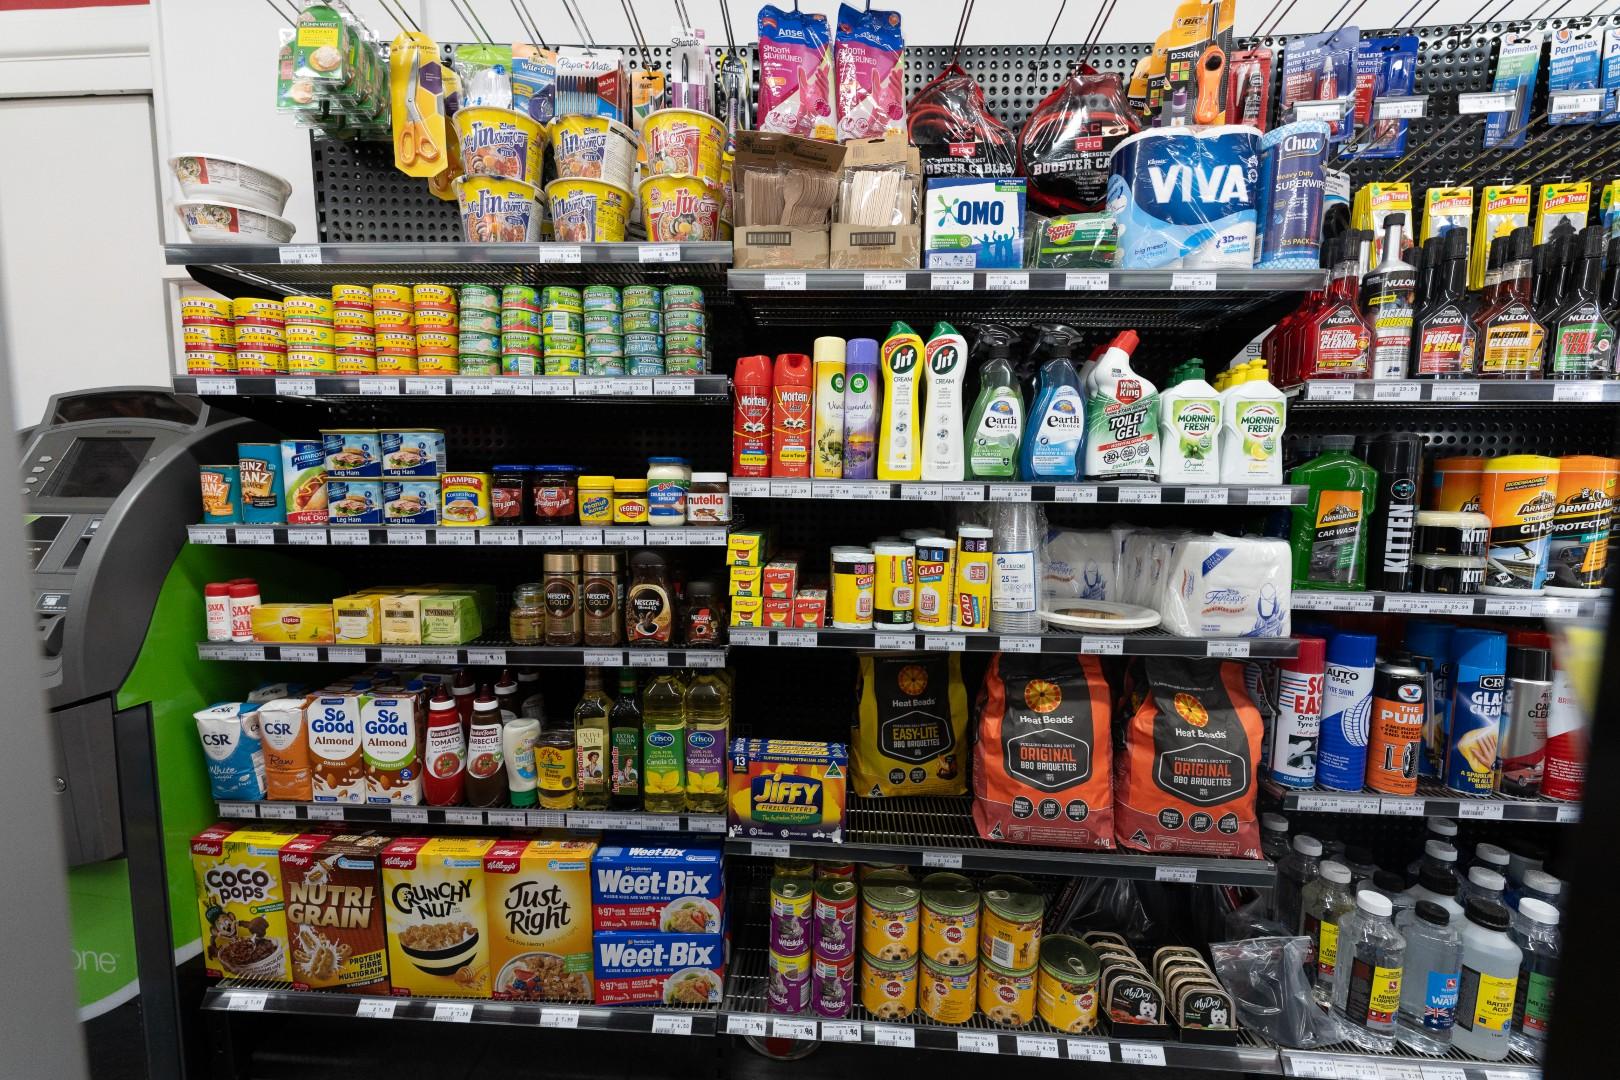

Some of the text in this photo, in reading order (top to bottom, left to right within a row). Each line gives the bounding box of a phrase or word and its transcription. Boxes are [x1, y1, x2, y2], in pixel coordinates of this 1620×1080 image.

[671, 37, 701, 49] Sharpie
[1555, 40, 1598, 56] Permatex
[763, 45, 790, 54] SMOOTH
[1171, 50, 1200, 60] DESIGN
[1502, 45, 1538, 56] Permatex
[558, 57, 612, 71] Paper Mate
[763, 53, 803, 63] SILVERLINED
[471, 122, 495, 151] Jin
[1076, 140, 1103, 149] PRO
[1284, 136, 1318, 152] Chux
[1033, 160, 1090, 176] BOOSTER
[1276, 170, 1313, 182] Heavy Duty
[1147, 164, 1249, 204] VIVA
[476, 189, 503, 219] Jin
[674, 188, 698, 219] Jin
[1372, 192, 1409, 206] Little Trees
[1431, 198, 1471, 211] Little Trees
[1488, 197, 1527, 211] Little Trees
[1544, 194, 1586, 210] Little Trees
[957, 200, 1004, 225] OMO
[1047, 222, 1077, 235] Scotch
[1050, 229, 1075, 242] Brite
[1384, 278, 1416, 288] NULON
[1328, 317, 1355, 325] NULON
[1432, 317, 1461, 325] NULON
[1498, 314, 1529, 322] NULON
[1424, 334, 1461, 344] BOOST
[1489, 331, 1528, 339] INJECTOR
[1489, 338, 1529, 347] CLEANER
[896, 347, 914, 367] Jif
[935, 348, 953, 371] Jif
[781, 392, 808, 403] Mortein
[1120, 388, 1140, 399] King
[741, 396, 767, 407] Mortein
[985, 415, 1017, 429] earth
[1047, 415, 1079, 429] earth
[1110, 409, 1147, 431] TOILET
[1177, 415, 1216, 423] MORNING
[1241, 416, 1280, 425] MORNING
[1116, 425, 1141, 441] GEL
[1184, 423, 1210, 431] FRESH
[1247, 424, 1274, 433] FRESH
[445, 476, 478, 485] HAMPER
[687, 496, 724, 506] nutella
[314, 514, 328, 522] Dog
[336, 516, 347, 524] Leg
[1318, 526, 1359, 538] CAR WASH
[1520, 520, 1555, 534] GLASS
[1384, 504, 1414, 573] KITTEN
[918, 565, 943, 576] GLAD
[1001, 575, 1010, 583] 25
[208, 603, 225, 612] SAXA
[960, 594, 972, 626] GLAD
[1327, 667, 1359, 680] AUTO
[892, 698, 935, 708] Heat Beads
[1400, 705, 1420, 713] THE
[324, 708, 345, 721] So
[377, 710, 399, 722] So
[1020, 715, 1073, 725] Heat Beads
[1381, 711, 1423, 724] PUM
[265, 722, 292, 735] CSR
[312, 719, 354, 735] Good
[365, 722, 408, 735] Good
[893, 726, 939, 740] EASY-LITE
[1175, 727, 1226, 739] Heat Beads
[203, 734, 232, 746] CSR
[314, 736, 354, 746] Almond
[368, 738, 407, 747] Almond
[431, 737, 461, 746] TOMATO
[648, 735, 674, 745] Crisco
[688, 735, 715, 745] Crisco
[907, 738, 940, 748] BRIQUETTES
[269, 754, 293, 766] Raw
[1020, 746, 1076, 762] ORIGINAL
[686, 758, 711, 767] egetable
[735, 756, 746, 767] 13
[1020, 761, 1077, 772] BBQ BRIQUETTES
[210, 765, 237, 775] White
[1173, 761, 1231, 777] ORIGINAL
[1173, 775, 1231, 787] BBQ BRIQUETTES
[754, 781, 820, 804] JIFFY
[760, 805, 813, 813] FIRELIGHTERS
[733, 824, 742, 832] 24
[193, 843, 219, 854] Kellogg's
[628, 846, 685, 858] Weet-Bix
[281, 854, 309, 865] Kellogg's
[384, 858, 413, 868] Kellogg's
[487, 861, 516, 871] Kellogg's
[206, 868, 269, 888] COCO
[597, 869, 712, 895] Weet-Bix
[220, 887, 264, 903] pops
[391, 879, 473, 915] CRUNCHY
[505, 881, 562, 909] Just
[415, 899, 452, 920] NUT
[287, 904, 372, 929] GRAIN
[505, 904, 571, 935] Right
[778, 937, 804, 947] whiskas
[819, 942, 846, 952] whiskas
[349, 953, 382, 965] PROTEIN
[600, 943, 714, 968] Weet-Bix
[359, 960, 382, 968] FIBRE
[338, 966, 383, 980] MULTIGRAIN
[1123, 987, 1152, 1000] MyDog
[819, 1000, 846, 1009] whiskas
[1193, 997, 1222, 1010] MyDog
[1486, 999, 1513, 1008] BATTERY
